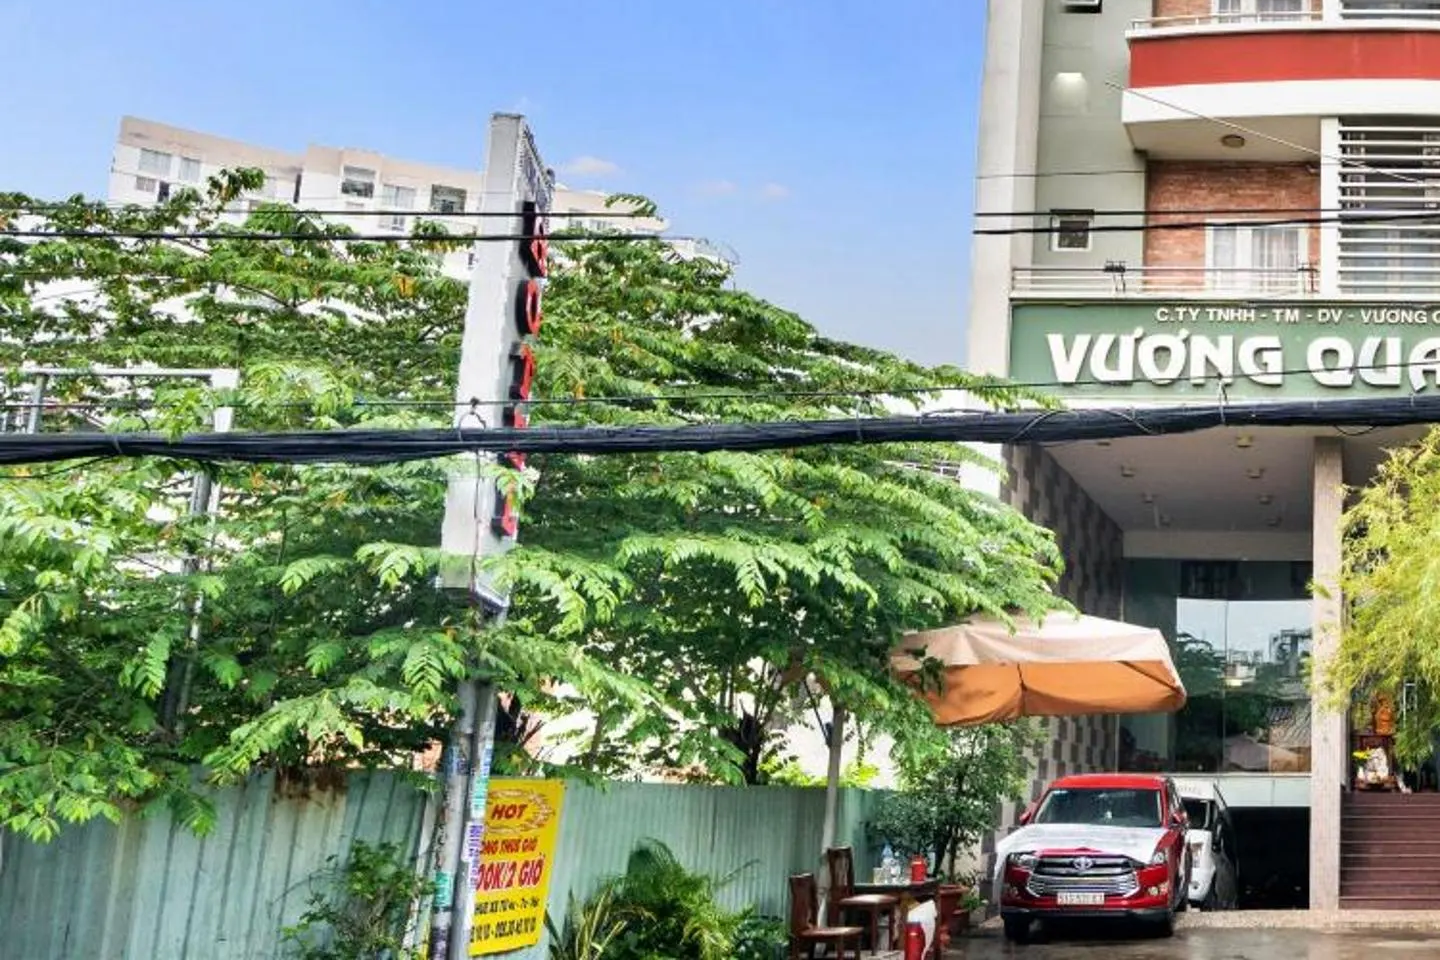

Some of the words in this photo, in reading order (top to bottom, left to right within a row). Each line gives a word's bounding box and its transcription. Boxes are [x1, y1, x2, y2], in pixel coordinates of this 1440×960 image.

[1155, 307, 1201, 323] C.TY
[1206, 308, 1256, 323] TNHH
[1273, 308, 1300, 323] TM
[1318, 309, 1344, 324] DV
[491, 803, 528, 820] HOT
